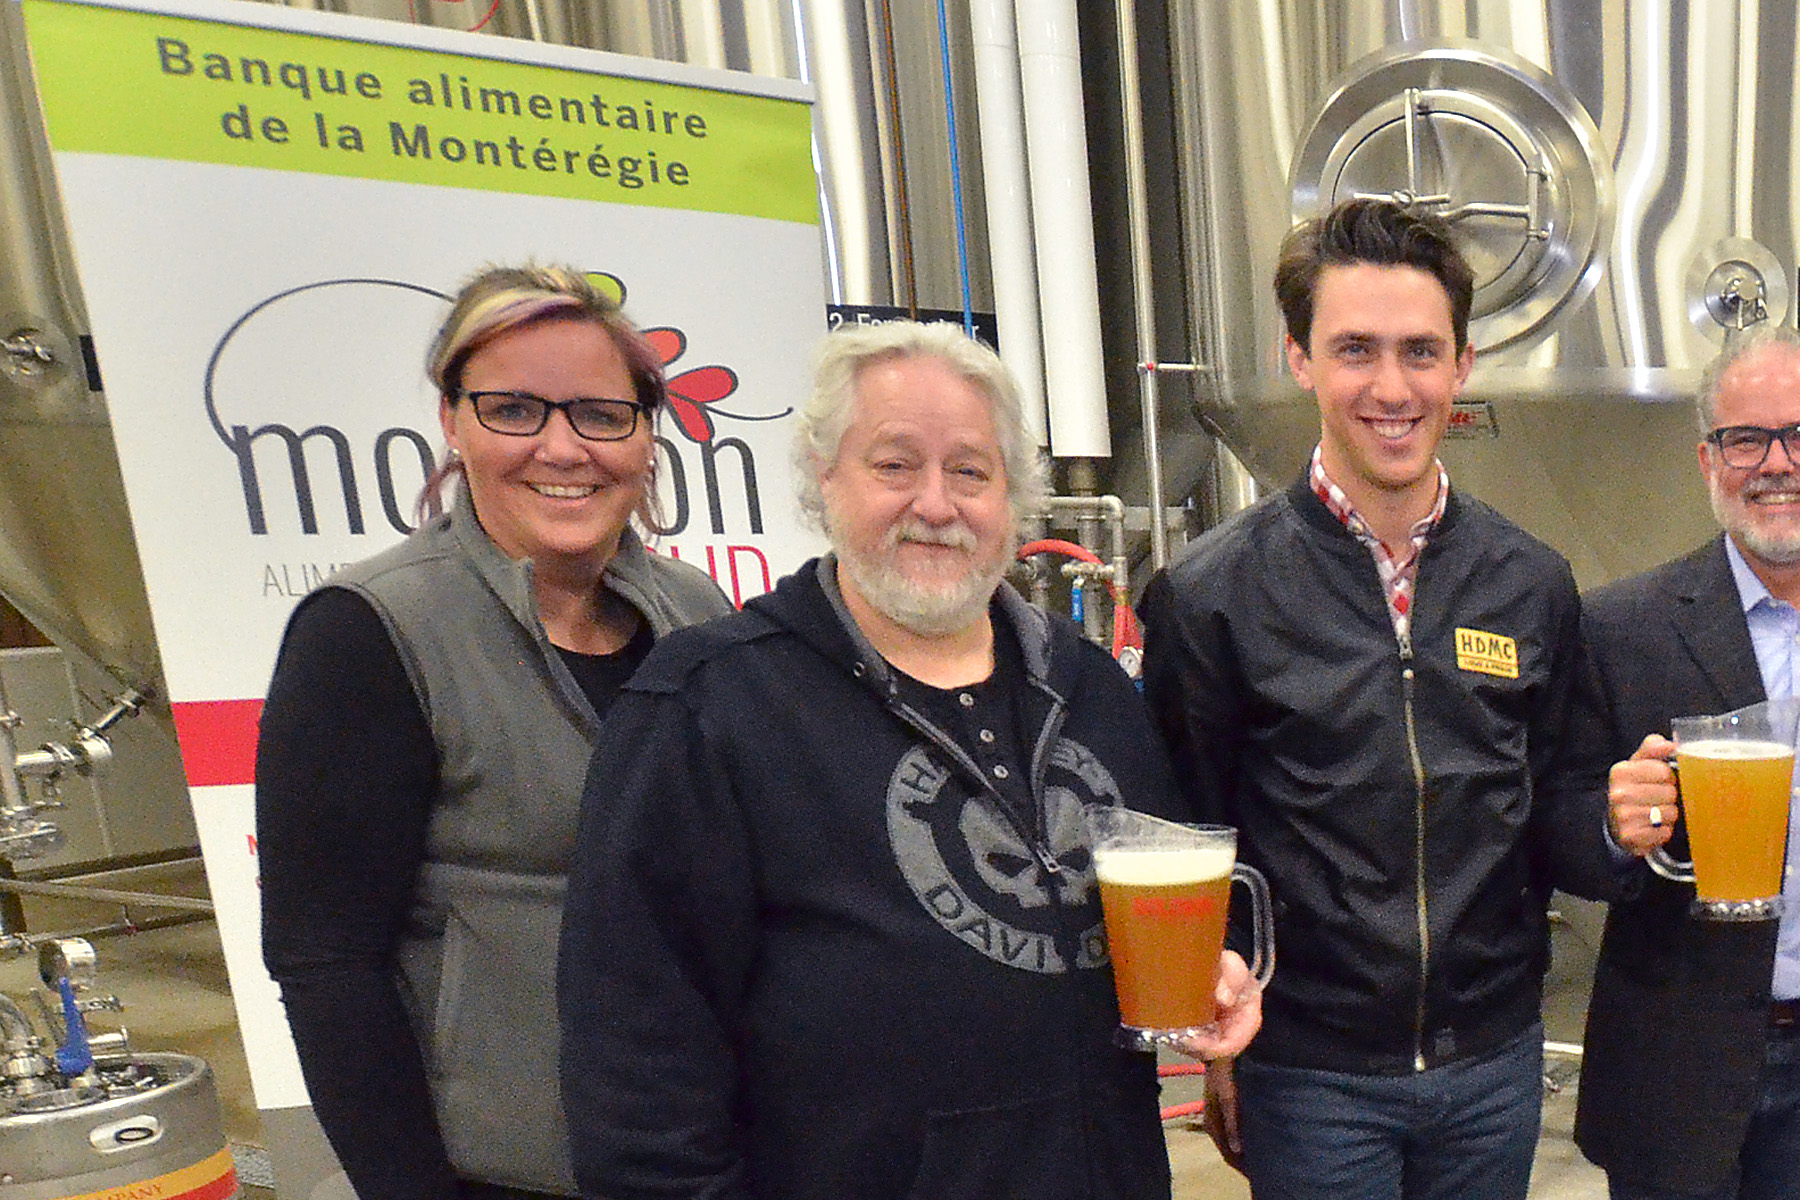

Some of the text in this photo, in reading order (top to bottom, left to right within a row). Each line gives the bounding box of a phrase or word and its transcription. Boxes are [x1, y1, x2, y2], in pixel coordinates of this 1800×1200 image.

[156, 36, 708, 138] Banque alimentaire
[220, 102, 690, 189] de la Montérégie
[1461, 634, 1512, 659] HDMC
